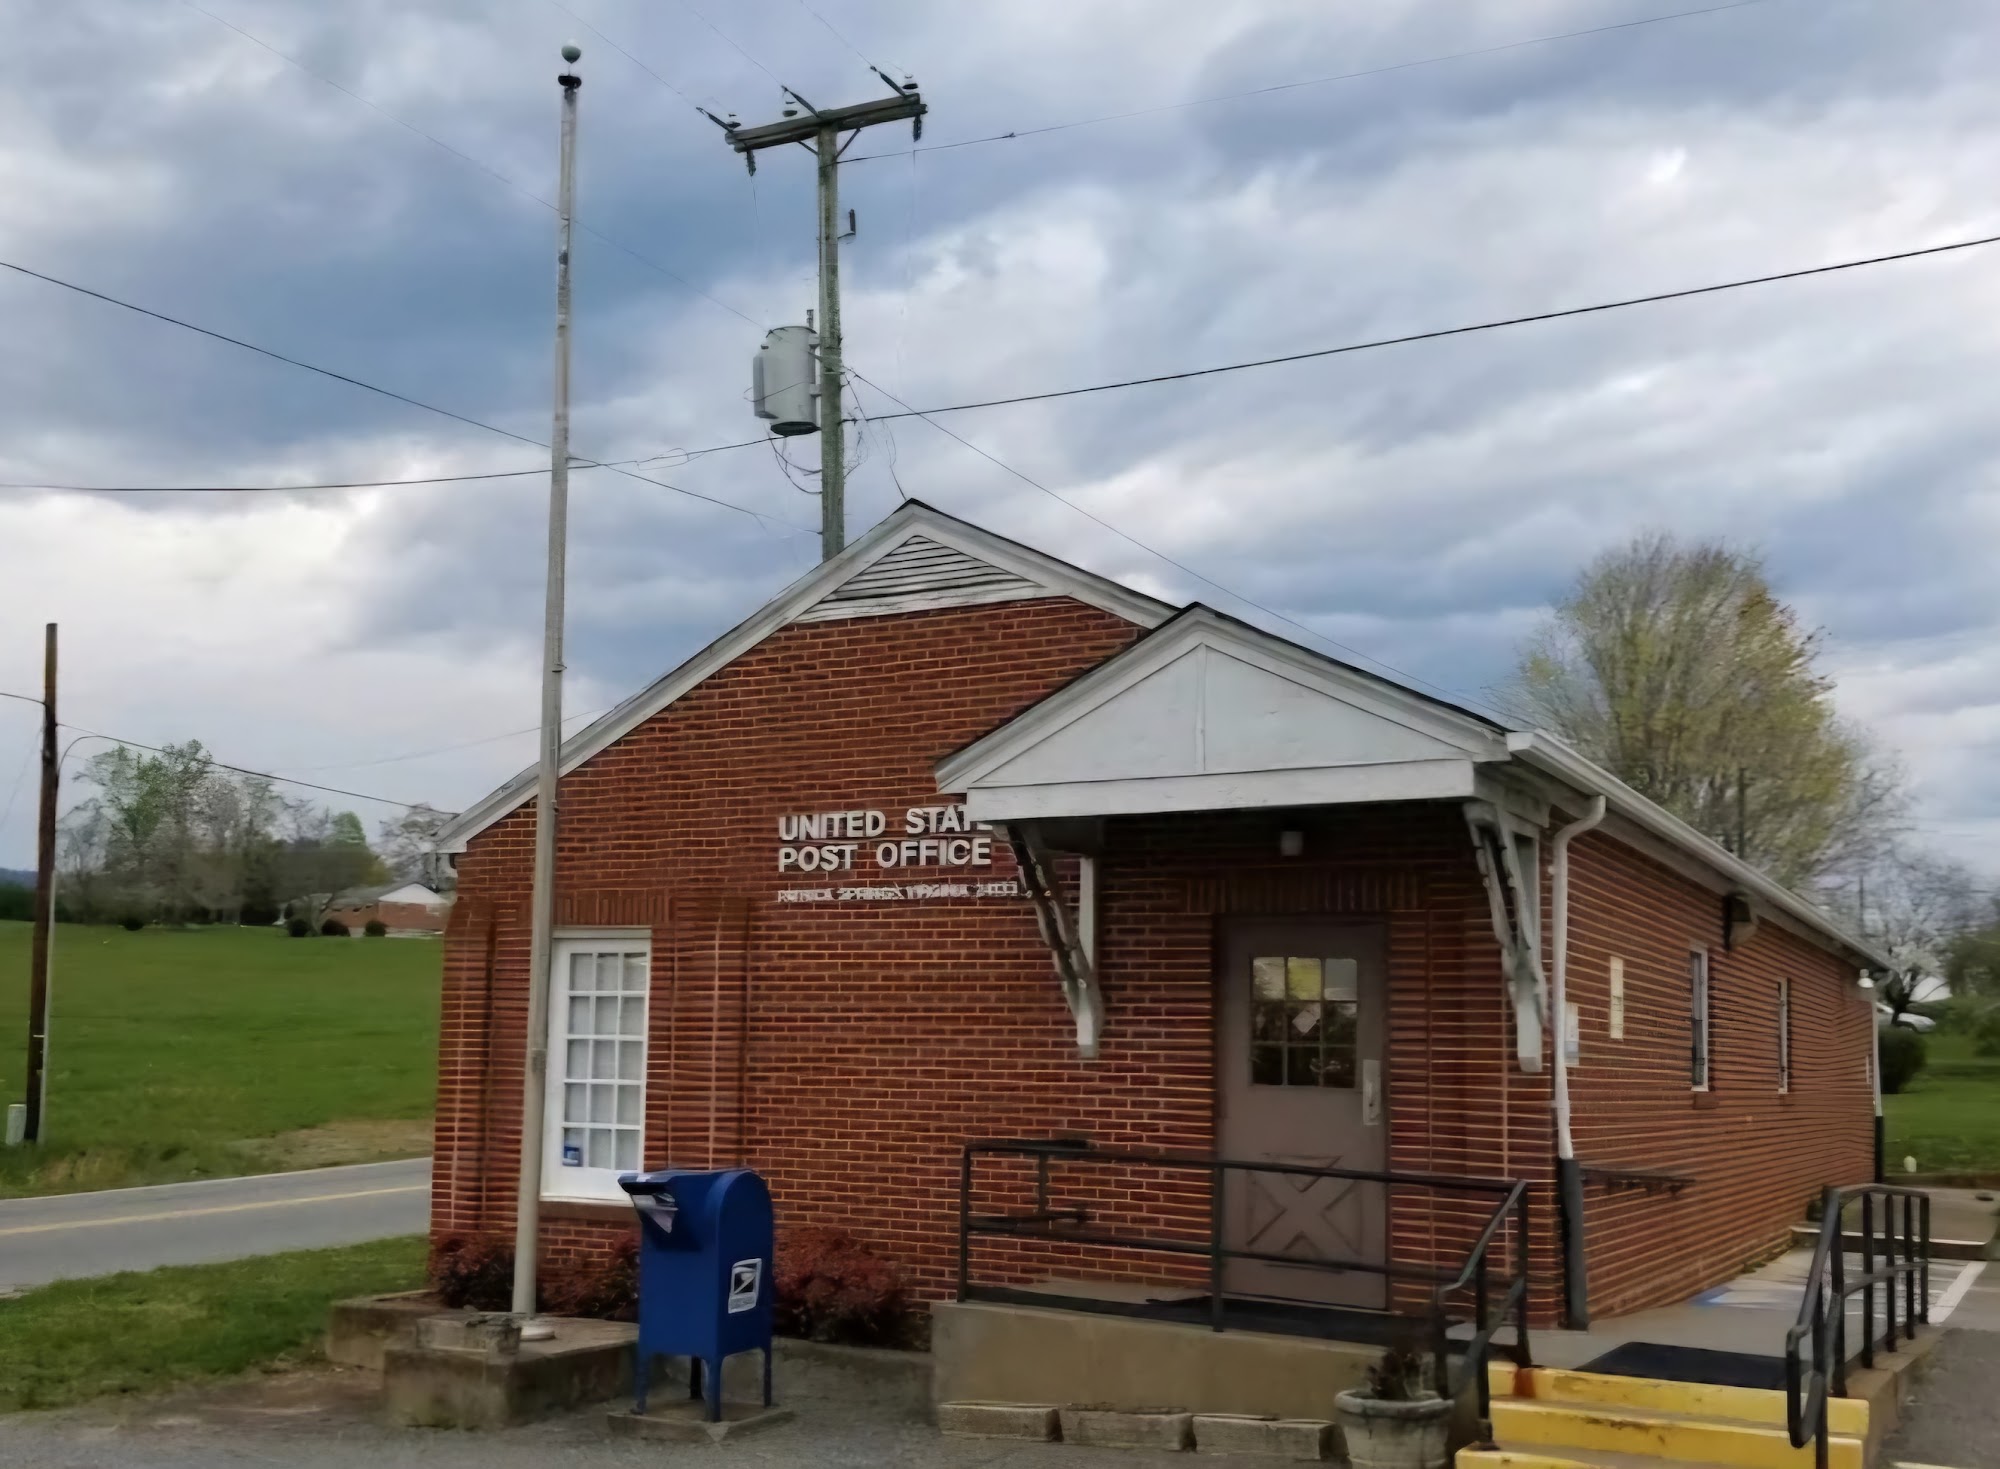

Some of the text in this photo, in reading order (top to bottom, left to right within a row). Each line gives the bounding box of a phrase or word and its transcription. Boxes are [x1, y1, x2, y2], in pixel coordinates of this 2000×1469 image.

[778, 804, 993, 841] UNITED STAT
[778, 838, 992, 873] POST OFFICE
